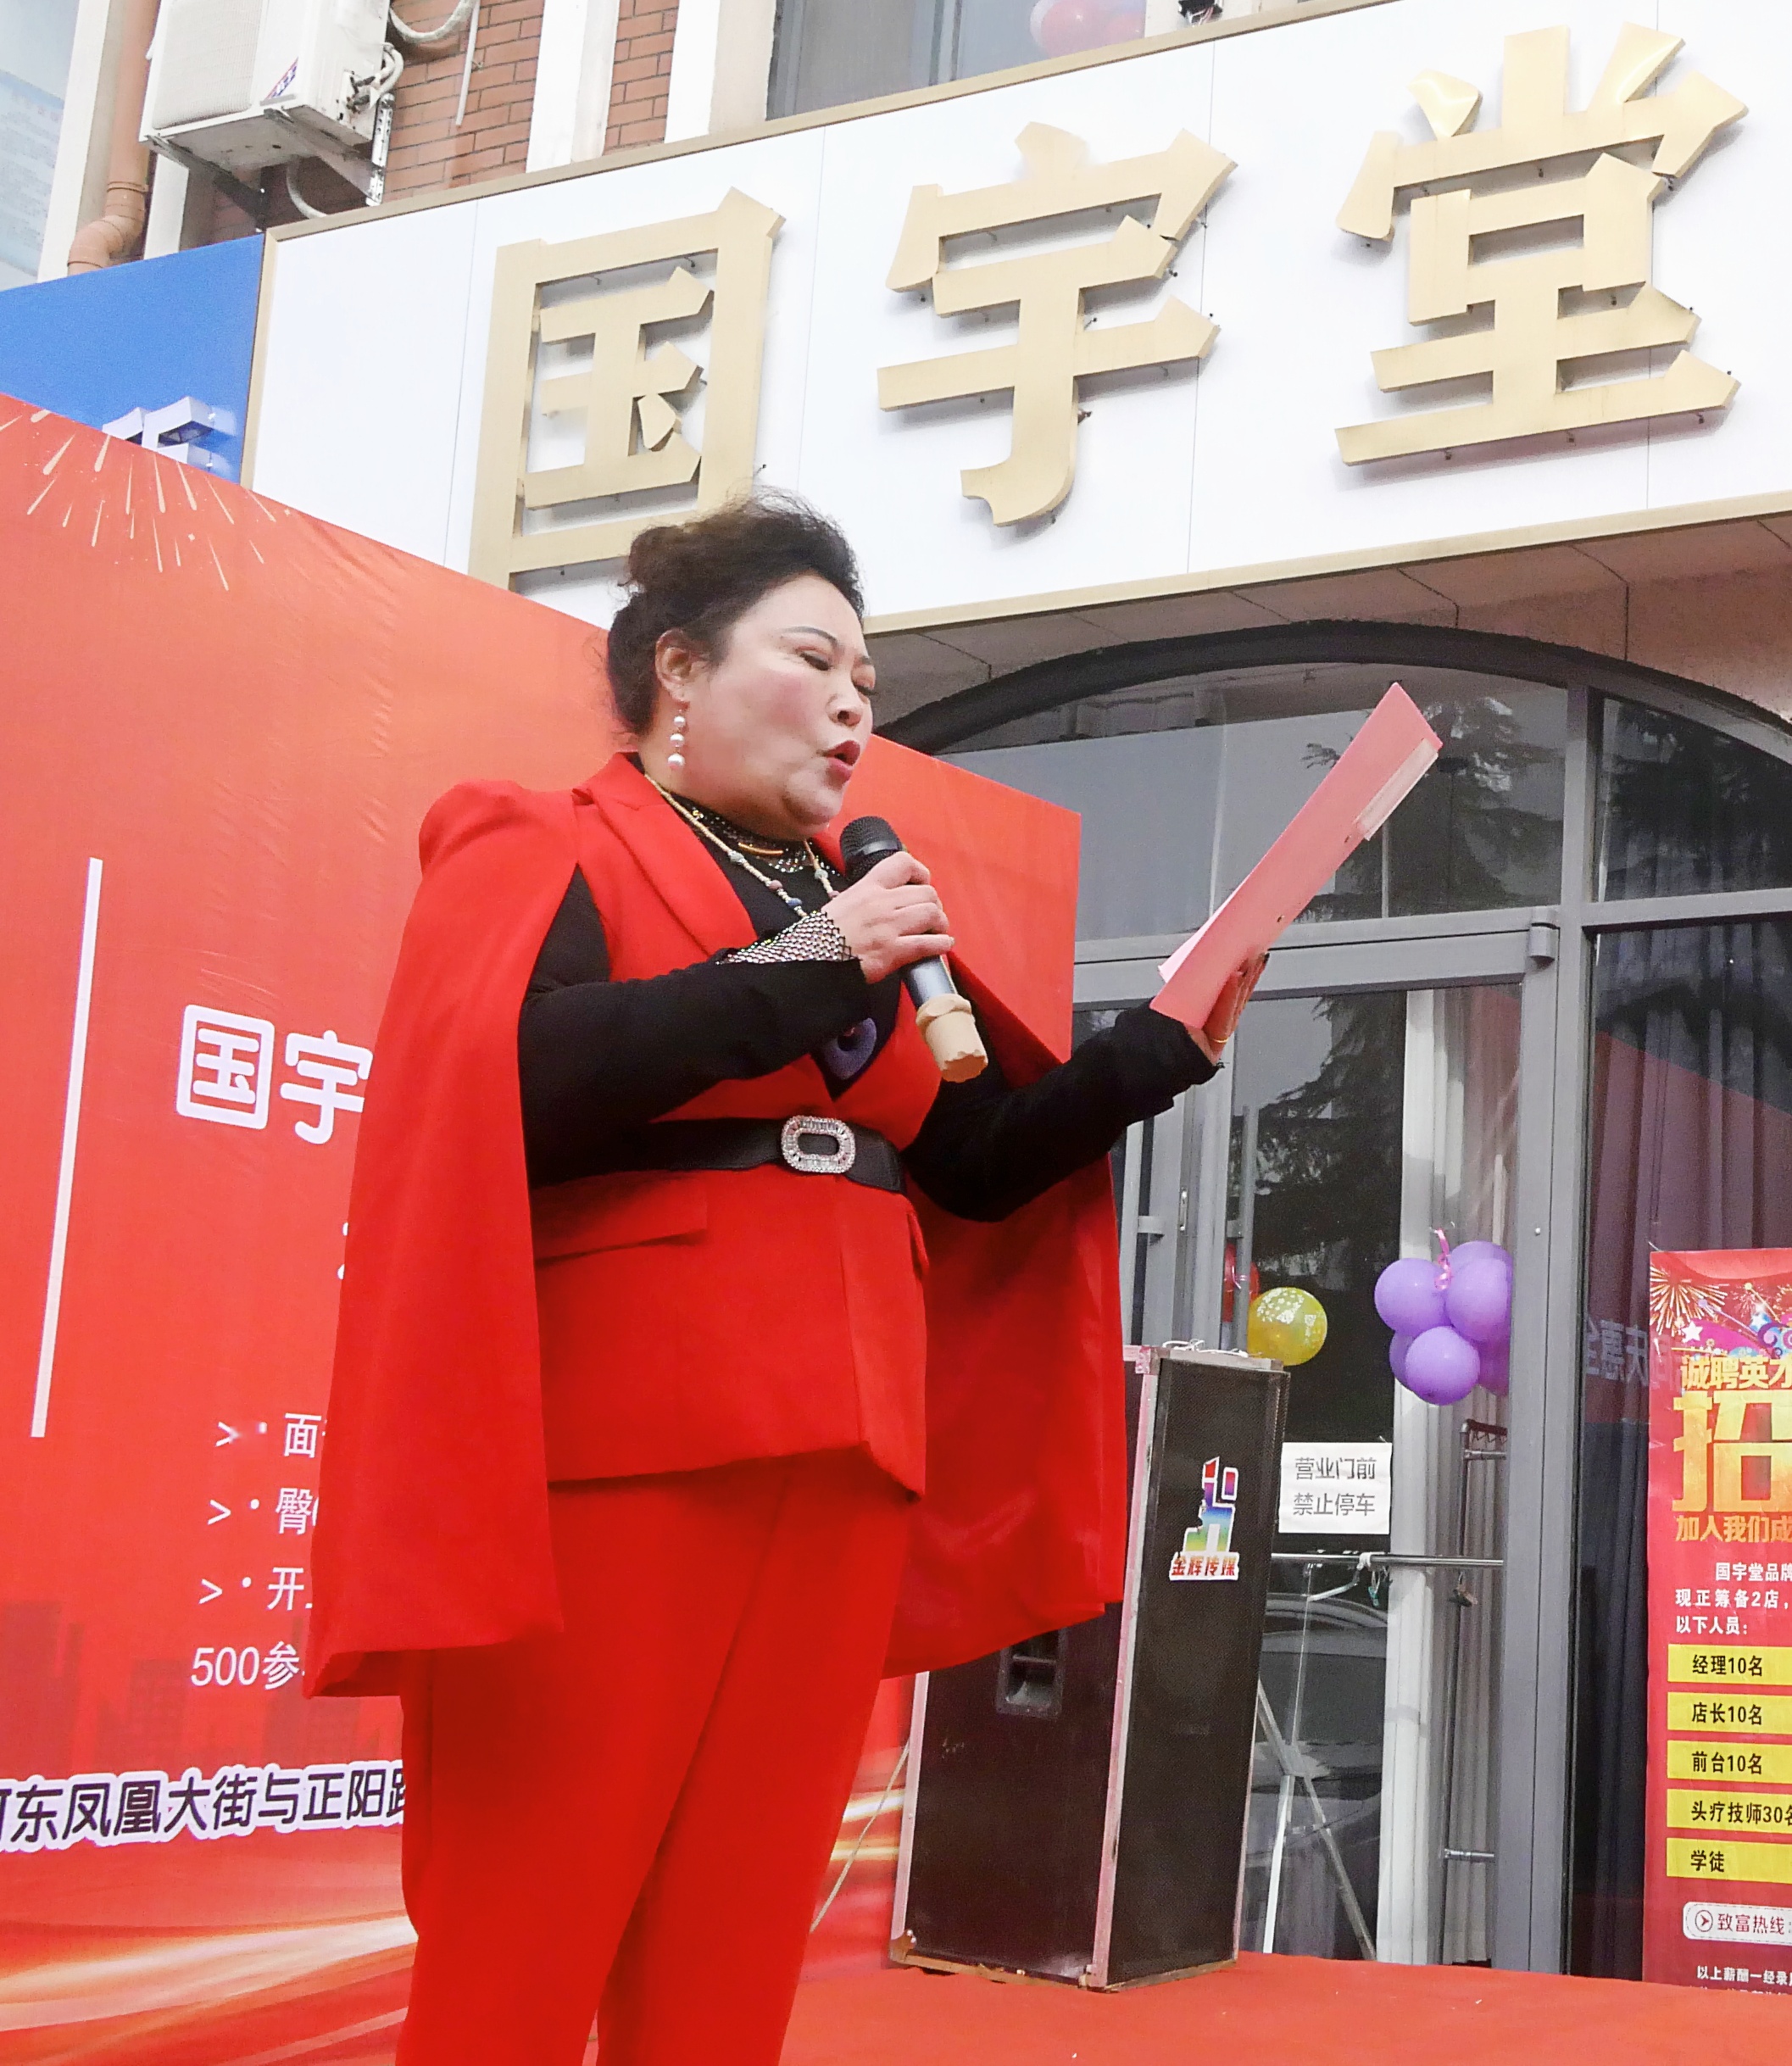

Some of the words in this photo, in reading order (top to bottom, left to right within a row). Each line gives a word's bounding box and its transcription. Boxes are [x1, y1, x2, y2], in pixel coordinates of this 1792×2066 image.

[470, 23, 1749, 589] 国宇堂
[176, 1005, 373, 1144] 国宇
[1680, 1355, 1792, 1389] 诚聘英才
[283, 1412, 327, 1458] 面
[1672, 1390, 1792, 1512] 招
[1294, 1456, 1377, 1480] 营业门前
[275, 1488, 320, 1535] 臀
[1293, 1492, 1376, 1517] 禁止停车
[1171, 1556, 1236, 1577] 金辉传媒
[1715, 1562, 1792, 1582] 国宇堂品牌
[267, 1568, 314, 1611] 开
[191, 1641, 305, 1690] 500参
[1692, 1654, 1763, 1677] 经理10名
[1692, 1701, 1763, 1725] 店长10名
[1691, 1751, 1763, 1775] 前台10名
[1690, 1850, 1725, 1873] 学徒
